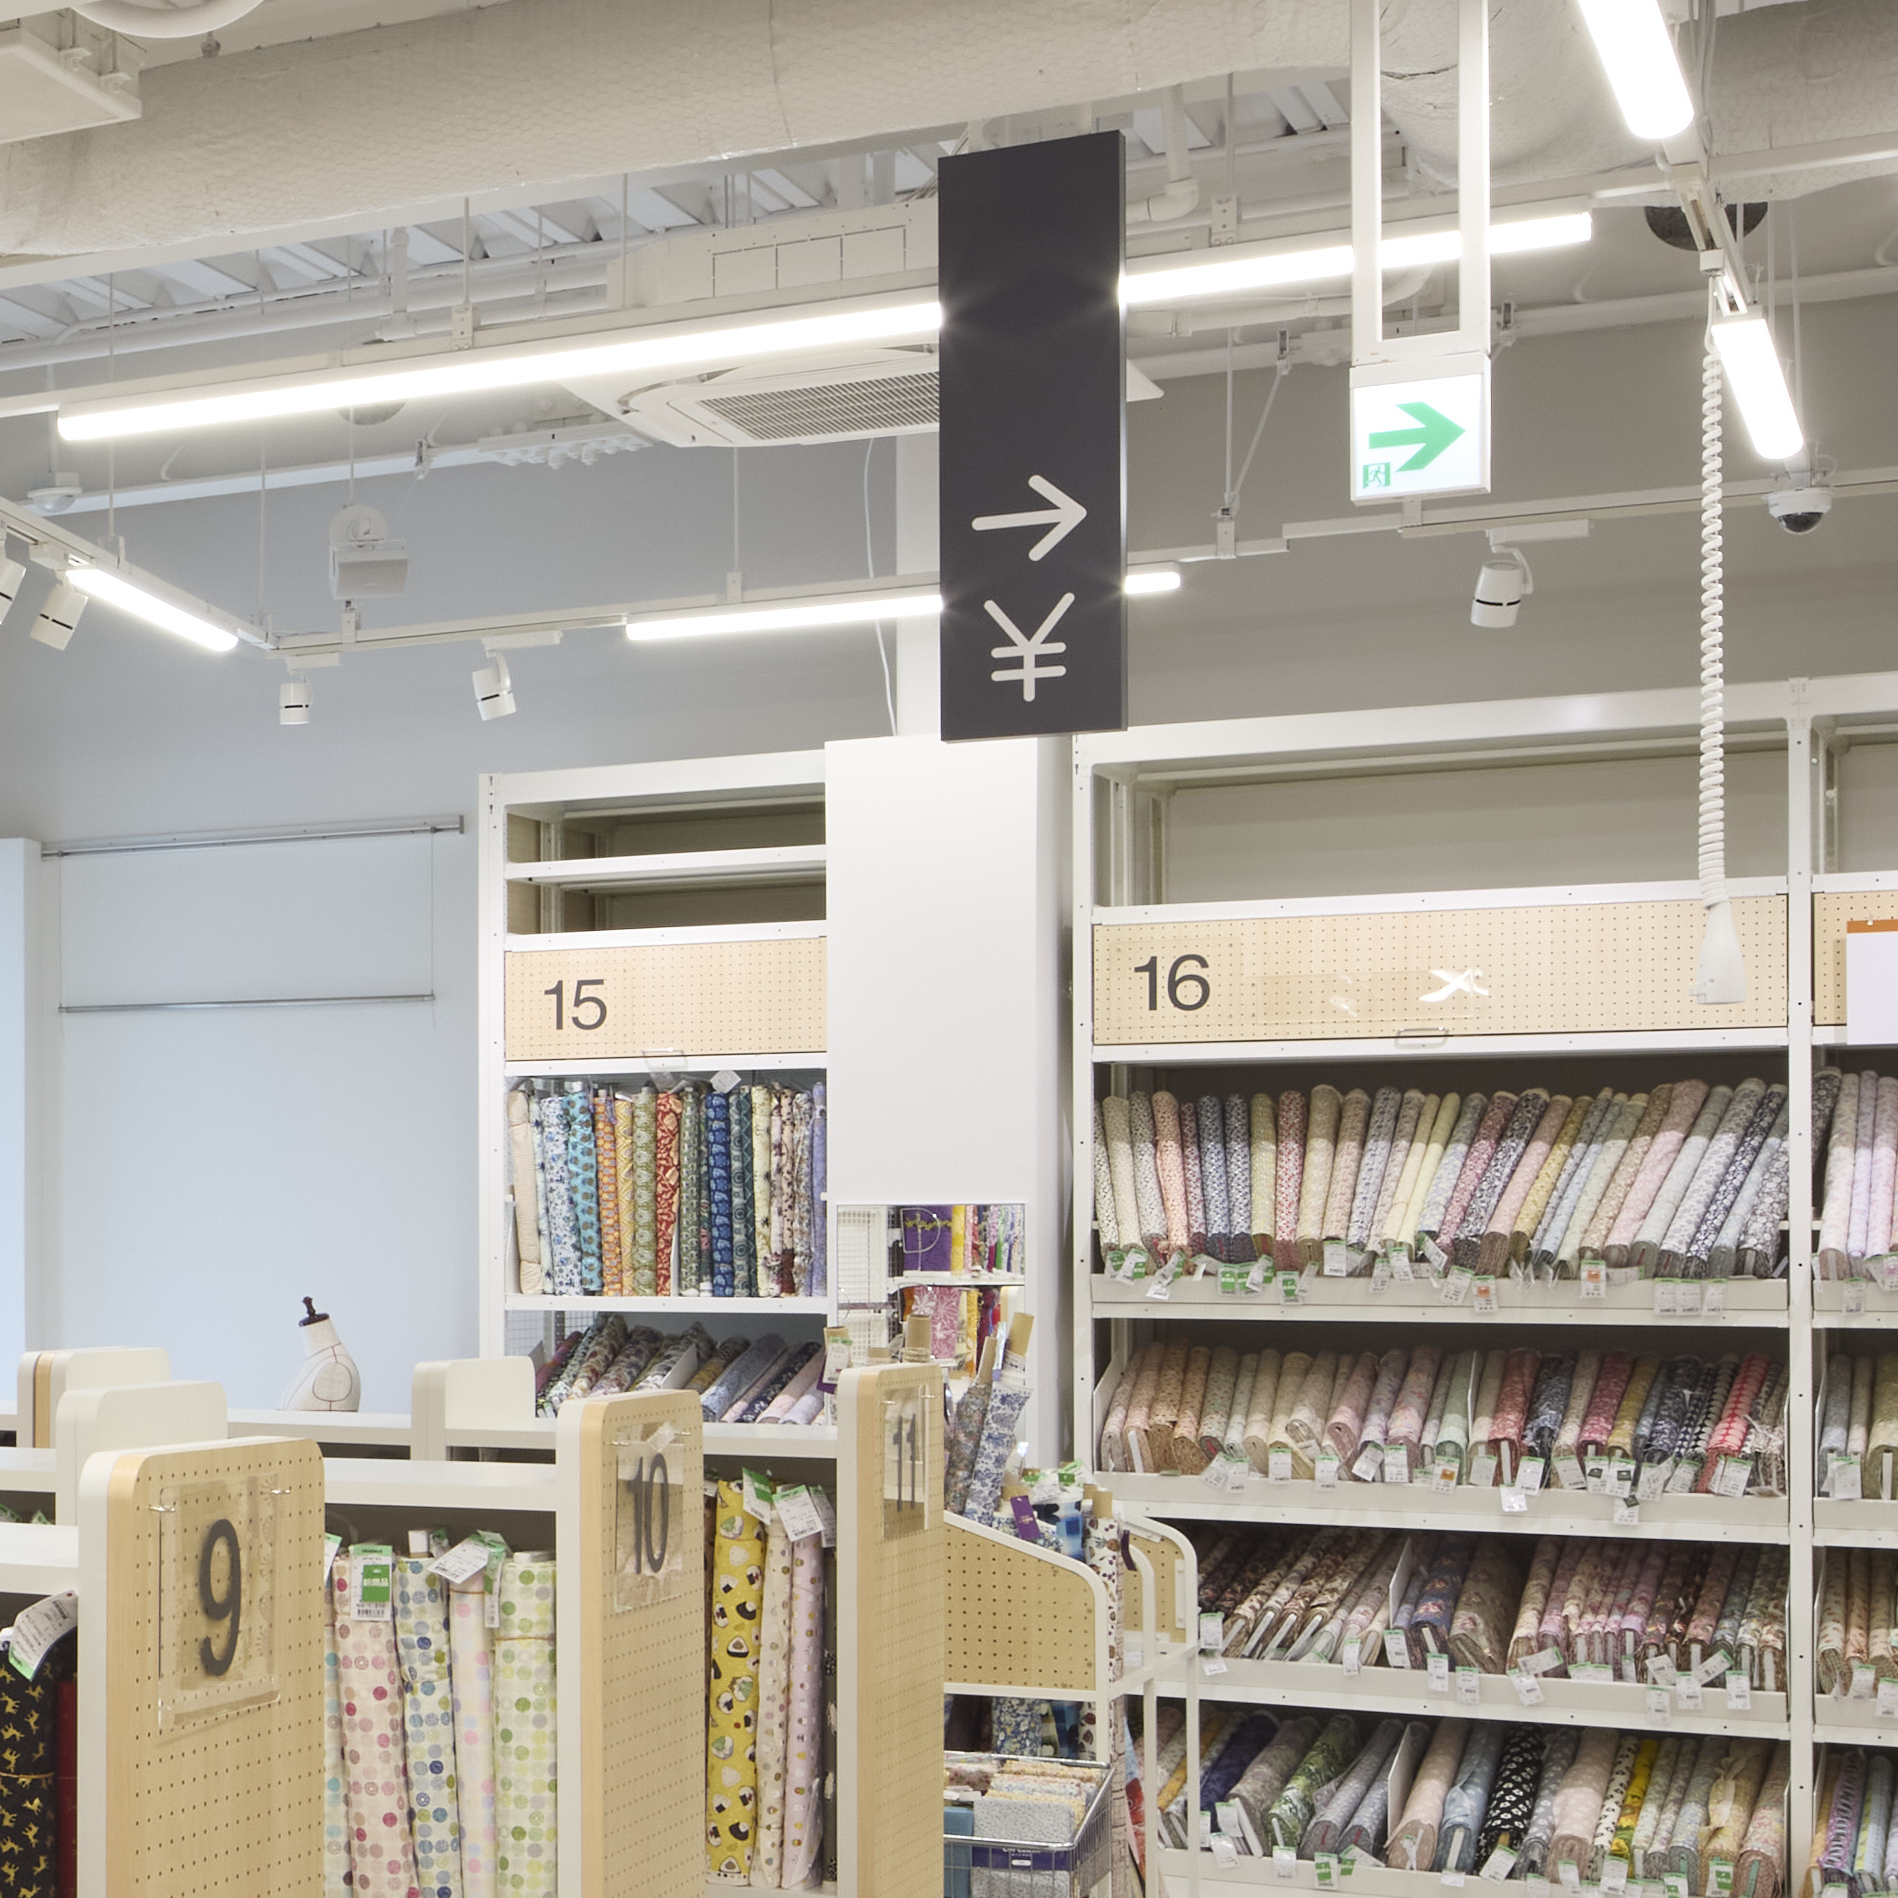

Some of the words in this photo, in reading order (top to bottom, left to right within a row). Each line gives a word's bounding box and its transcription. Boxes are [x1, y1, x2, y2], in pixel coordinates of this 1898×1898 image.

[544, 979, 608, 1031] 15
[1133, 953, 1212, 1012] 16
[892, 1413, 916, 1512] 11
[627, 1453, 669, 1575] 10
[199, 1519, 242, 1677] 9
